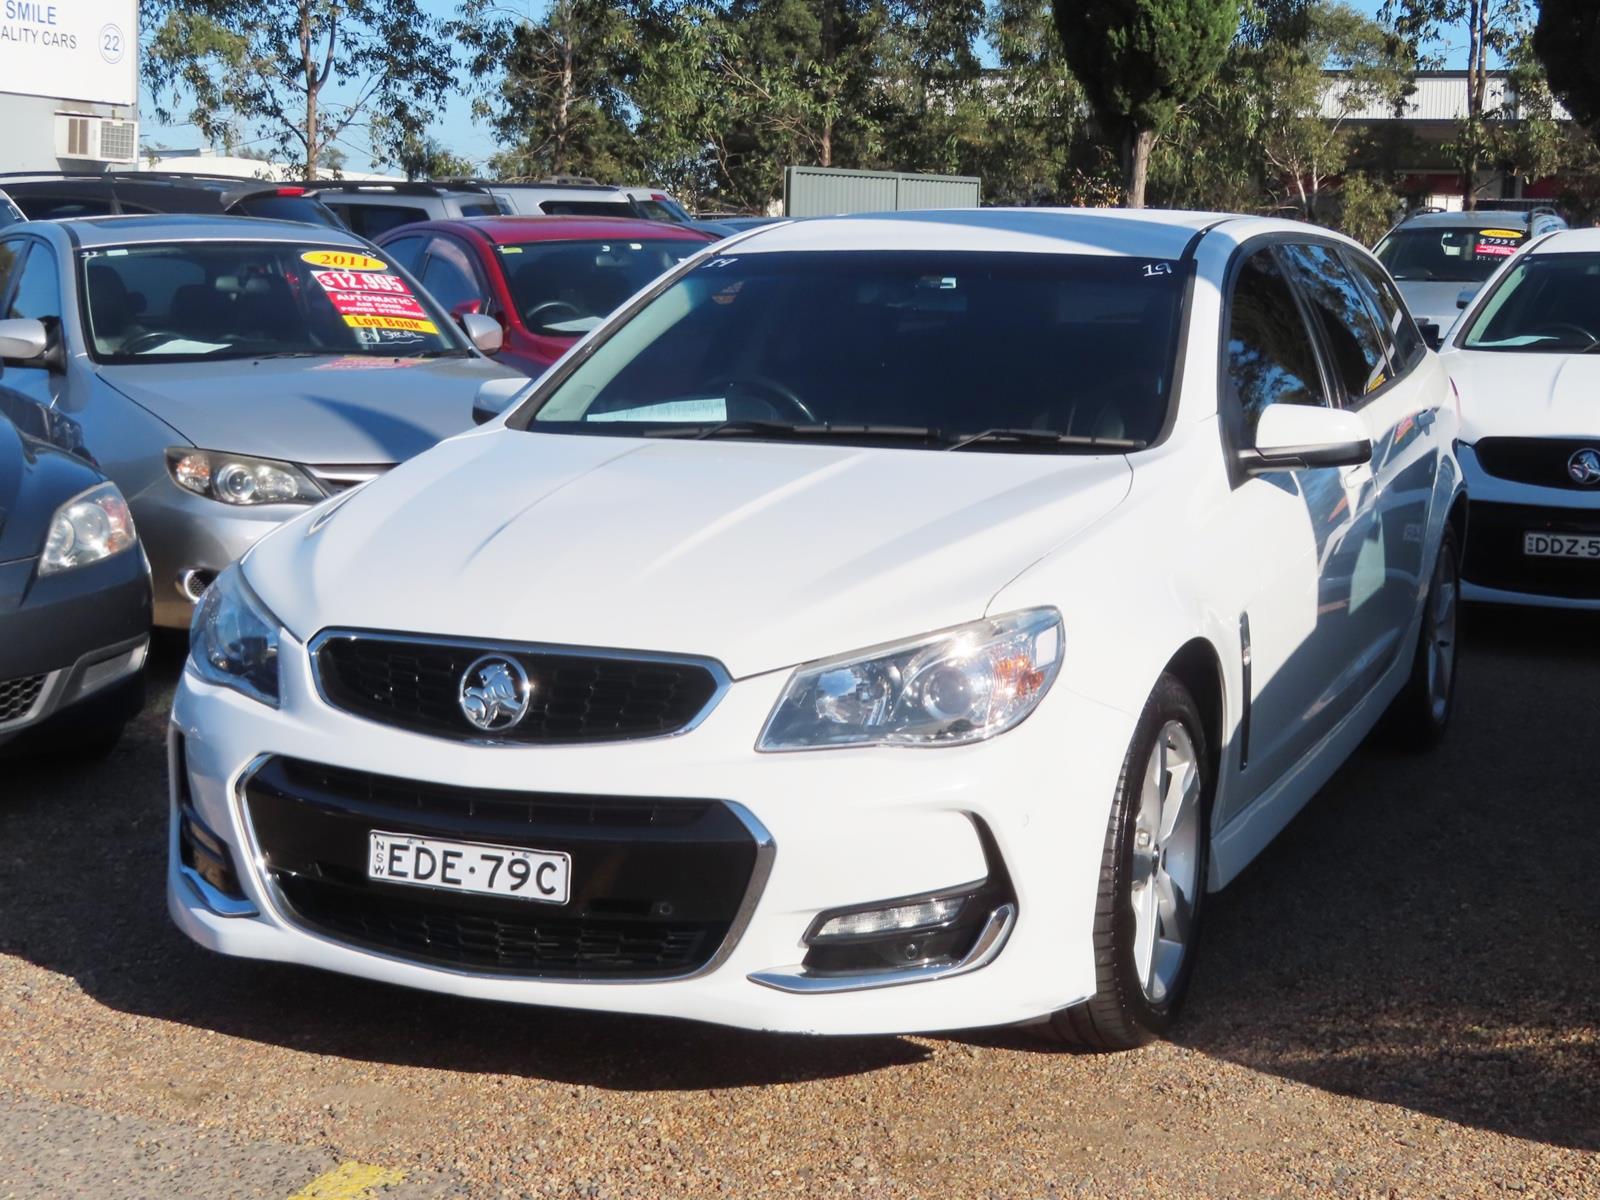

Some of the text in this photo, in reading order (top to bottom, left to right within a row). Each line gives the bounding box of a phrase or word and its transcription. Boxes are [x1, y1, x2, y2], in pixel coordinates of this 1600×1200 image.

[6, 0, 57, 25] SMILE
[41, 31, 77, 49] CARS
[103, 34, 120, 52] 22
[320, 254, 370, 267] 2011
[1142, 262, 1172, 277] 19
[320, 272, 404, 292] $12,995
[336, 294, 412, 306] AUTOMATIC
[353, 316, 422, 331] Log Book
[373, 840, 385, 876] NSW
